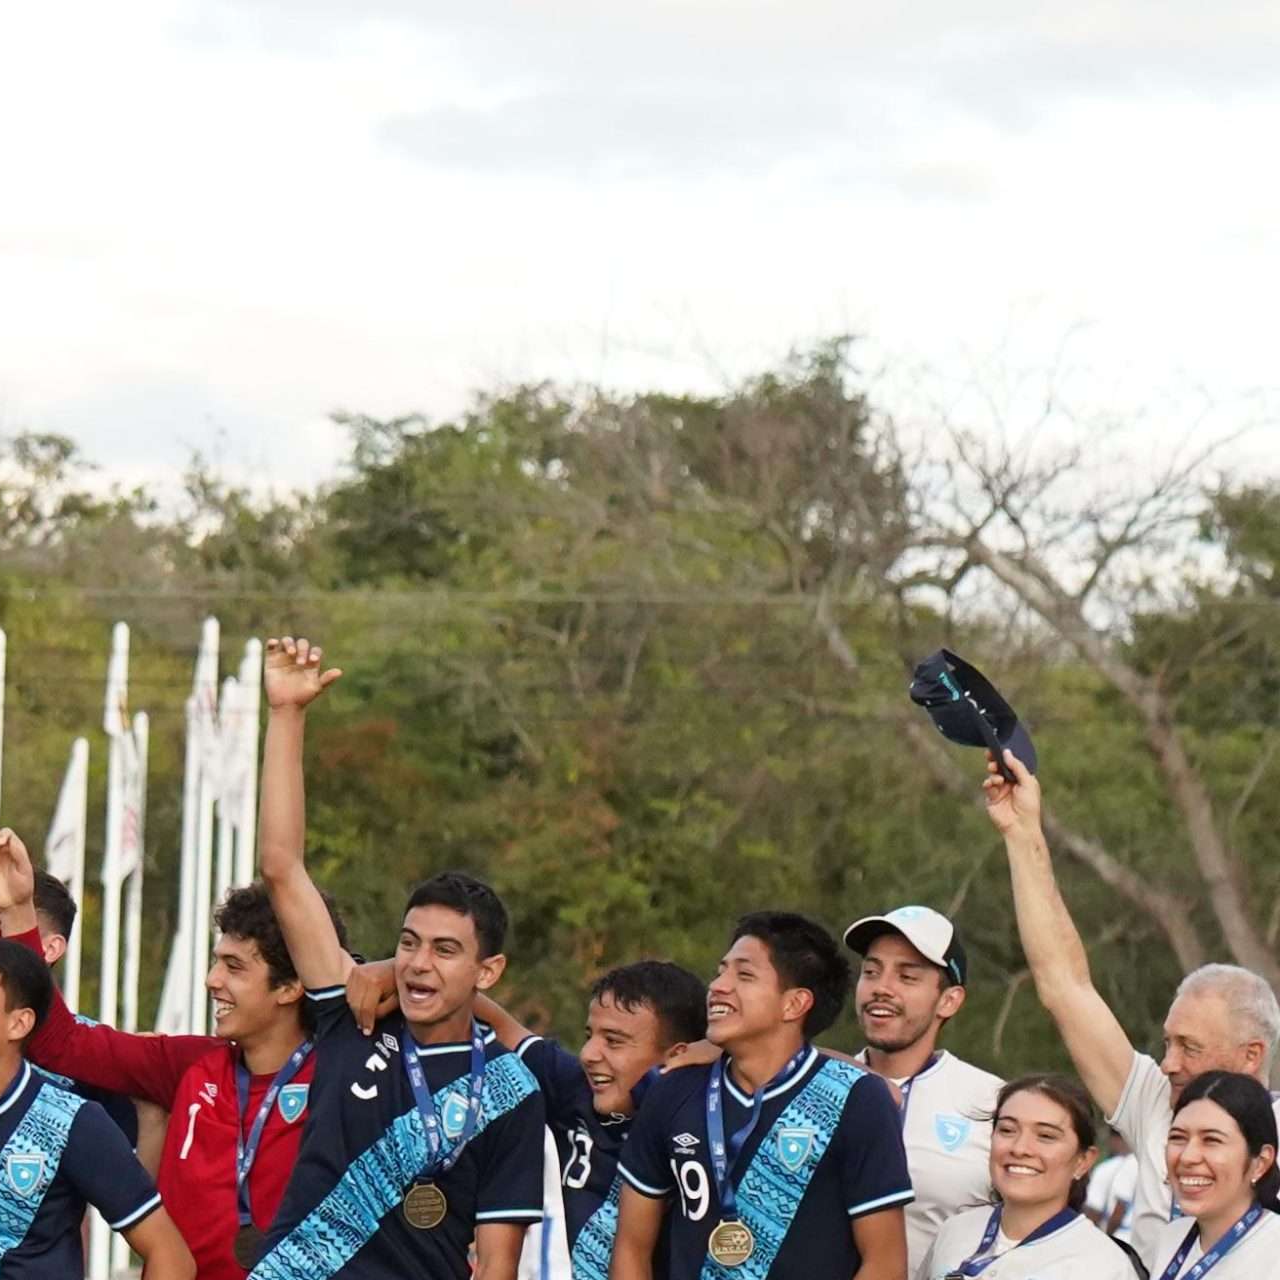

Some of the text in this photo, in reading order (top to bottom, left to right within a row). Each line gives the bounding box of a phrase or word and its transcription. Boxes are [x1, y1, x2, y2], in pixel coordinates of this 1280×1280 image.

[180, 1103, 202, 1160] 1
[562, 1129, 594, 1189] 13
[670, 1158, 710, 1221] 19
